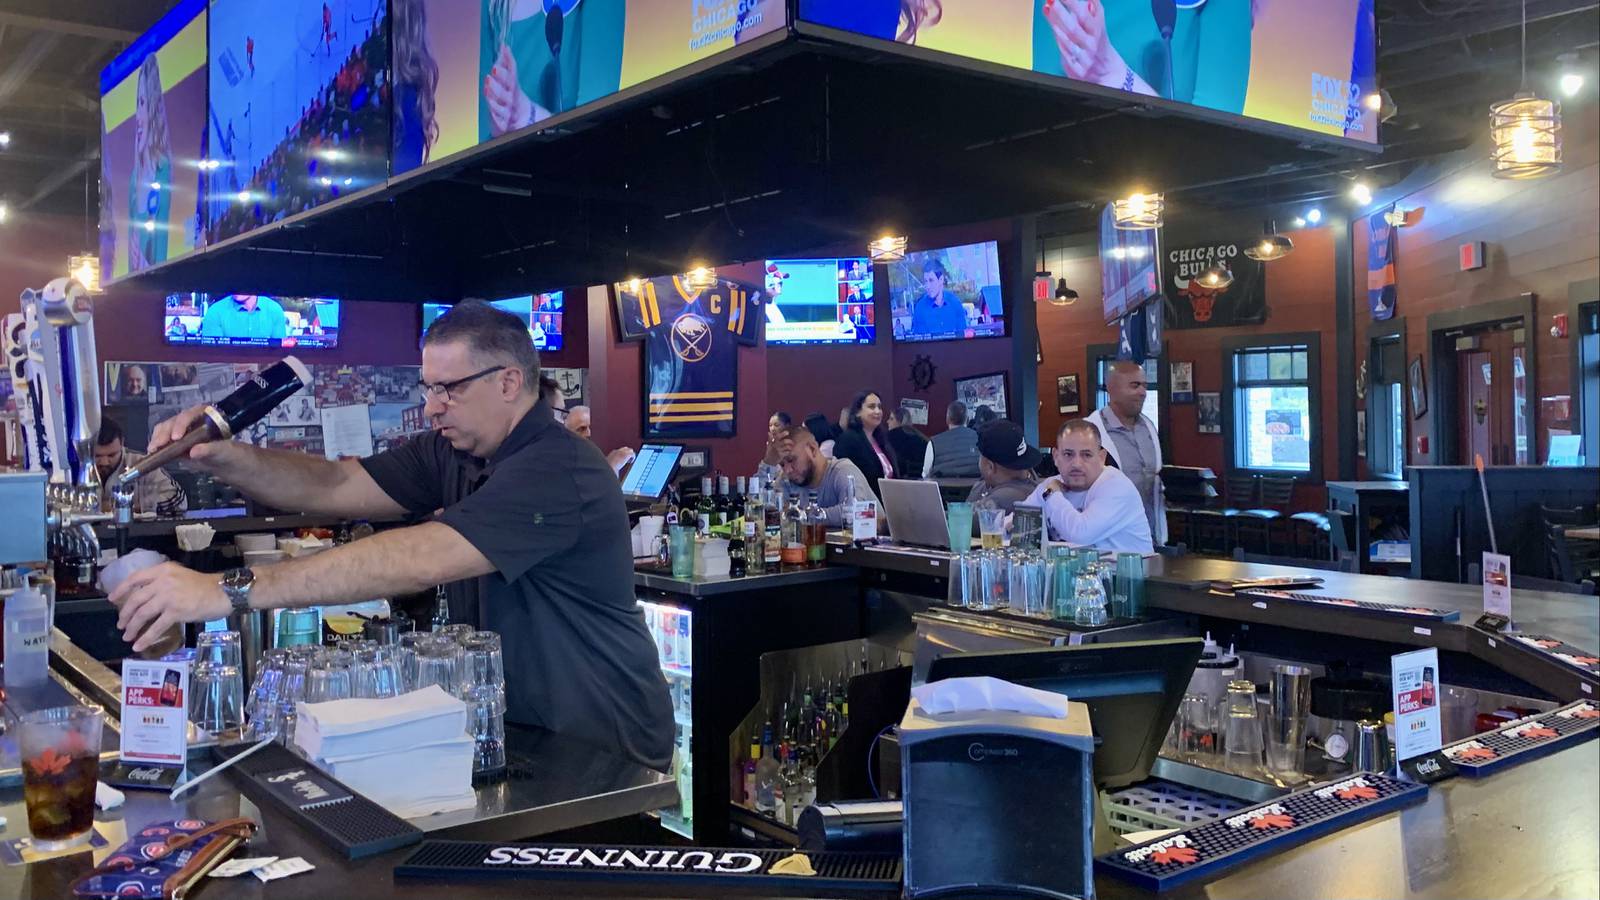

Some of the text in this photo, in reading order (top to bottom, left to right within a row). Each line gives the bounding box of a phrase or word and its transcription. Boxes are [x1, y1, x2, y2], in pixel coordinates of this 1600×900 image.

[1169, 244, 1238, 263] CHICAGO
[710, 294, 721, 314] C
[128, 688, 144, 698] APP
[483, 847, 763, 873] GUINNESS
